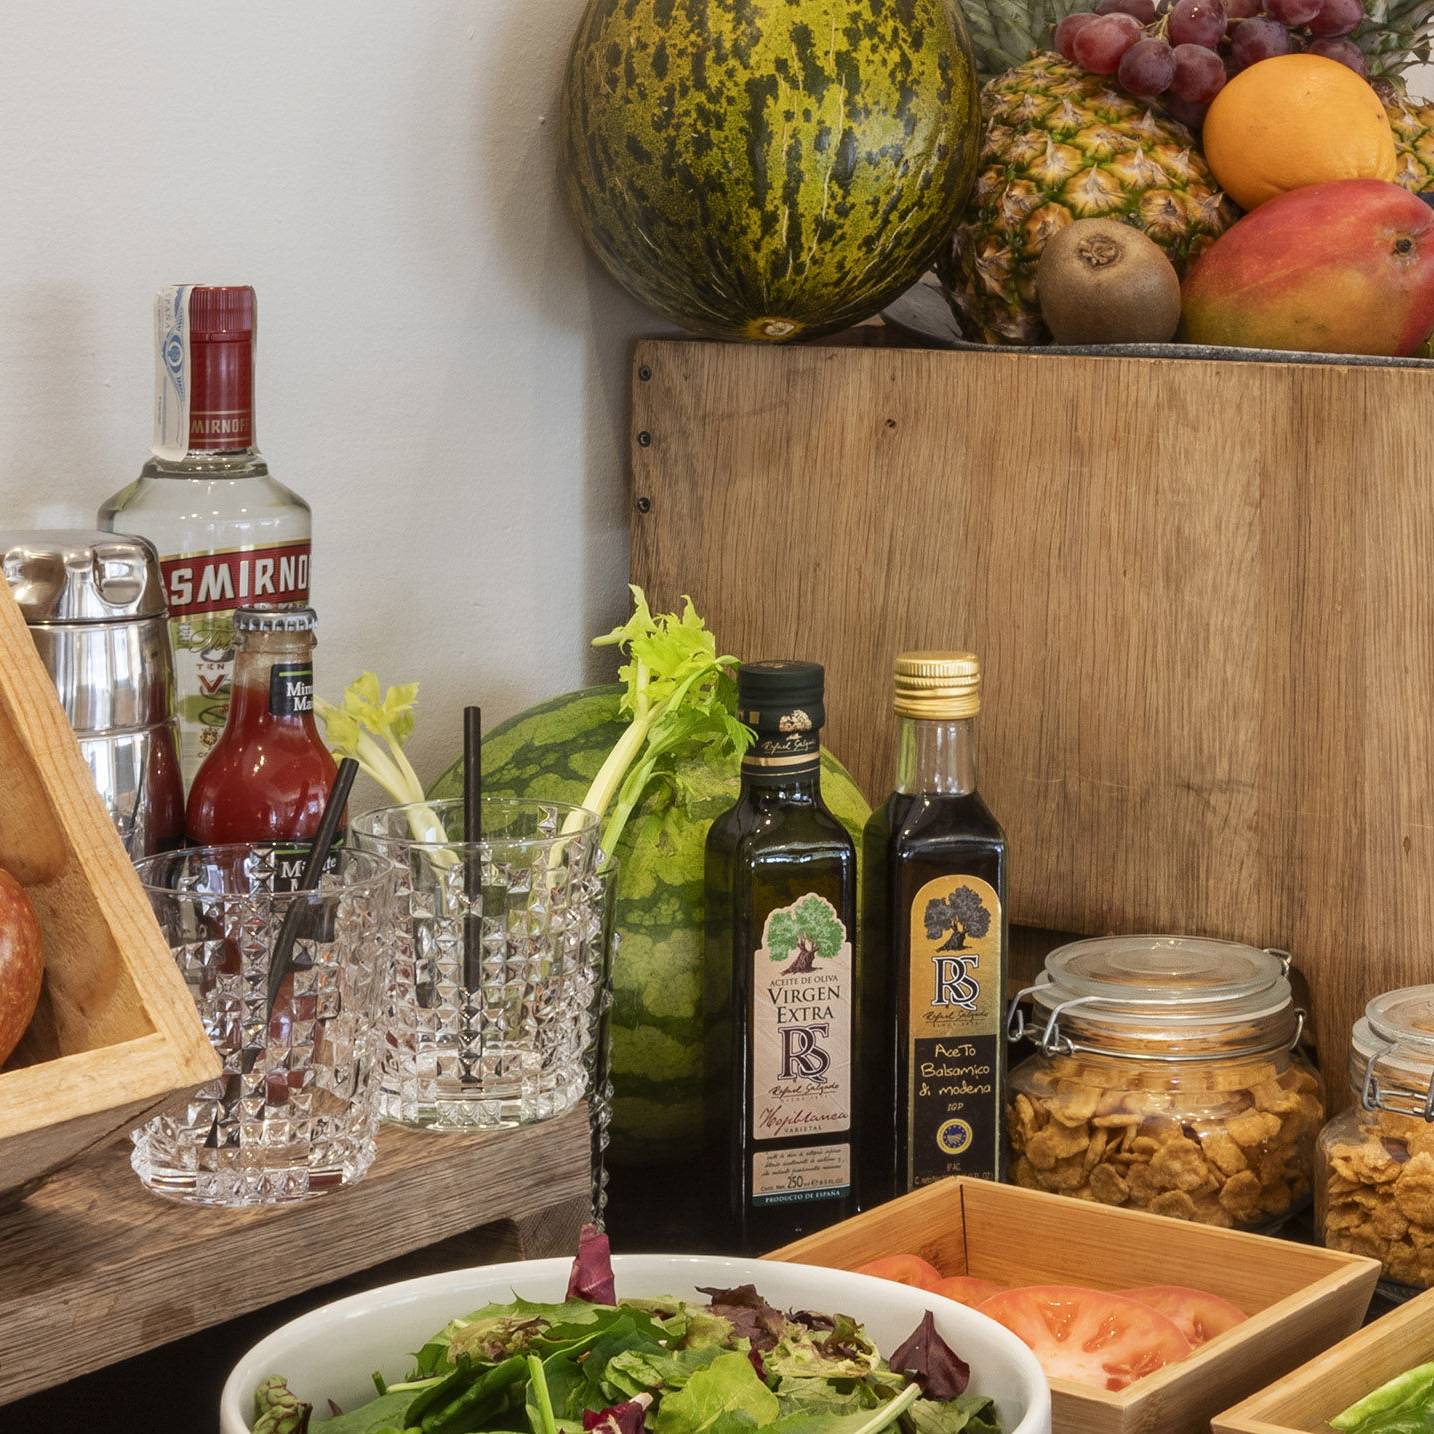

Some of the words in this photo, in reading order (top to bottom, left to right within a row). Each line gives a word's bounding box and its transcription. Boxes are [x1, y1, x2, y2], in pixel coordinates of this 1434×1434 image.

[191, 418, 250, 434] MIRNOFF
[170, 553, 311, 606] SMIRNO
[770, 977, 799, 987] ACEITE
[801, 976, 813, 985] DE
[814, 975, 839, 984] OLIVA
[767, 985, 840, 1005] VIRGEN
[777, 1006, 835, 1024] EXTRA
[920, 1062, 990, 1079] Balsamico
[938, 1080, 991, 1096] modena
[759, 1105, 848, 1137] Hojiblanca
[787, 1175, 803, 1189] 250
[765, 1193, 803, 1204] PRODUCTO
[804, 1192, 814, 1200] DE
[816, 1190, 840, 1199] ESPAÑA
